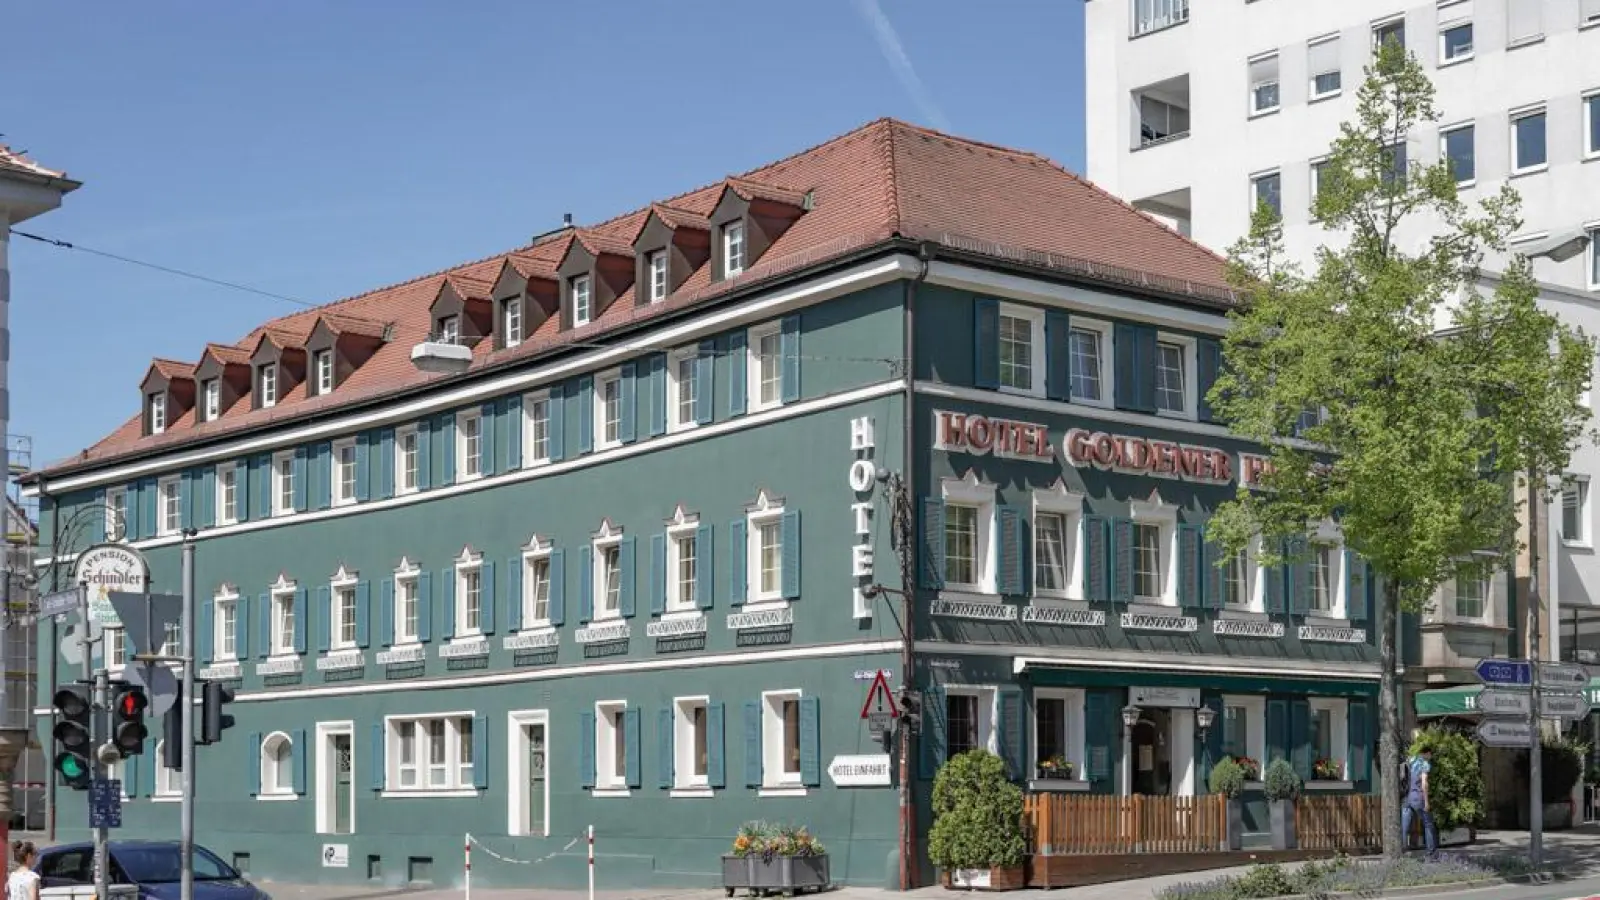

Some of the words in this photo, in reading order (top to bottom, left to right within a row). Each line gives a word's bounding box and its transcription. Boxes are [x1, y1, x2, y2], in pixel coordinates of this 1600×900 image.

[933, 409, 1053, 463] HOTEL
[1063, 428, 1233, 485] GOLDENER
[850, 416, 875, 619] HOTEL
[85, 551, 135, 568] PENSION
[82, 568, 140, 585] Schindler
[833, 764, 853, 776] HOTEL
[855, 763, 887, 776] EINFAHRT
